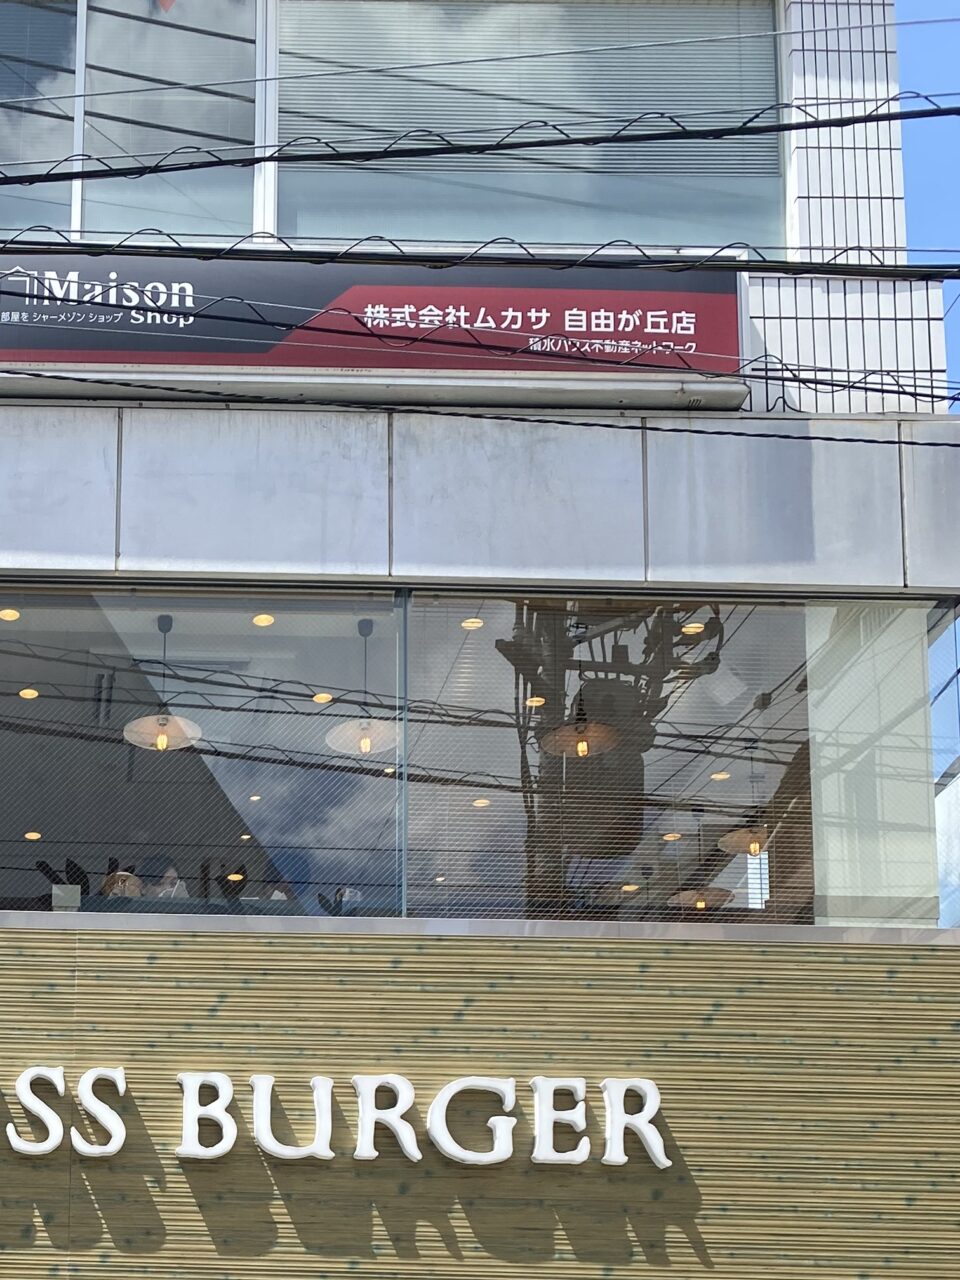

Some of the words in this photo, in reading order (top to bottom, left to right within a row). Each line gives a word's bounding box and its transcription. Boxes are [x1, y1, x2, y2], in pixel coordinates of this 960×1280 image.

[43, 270, 196, 308] Maison
[88, 312, 124, 324] ショップ
[363, 303, 551, 330] 株式会社ムカサ
[564, 308, 697, 335] 自由が丘店
[174, 1070, 673, 1170] BURGER
